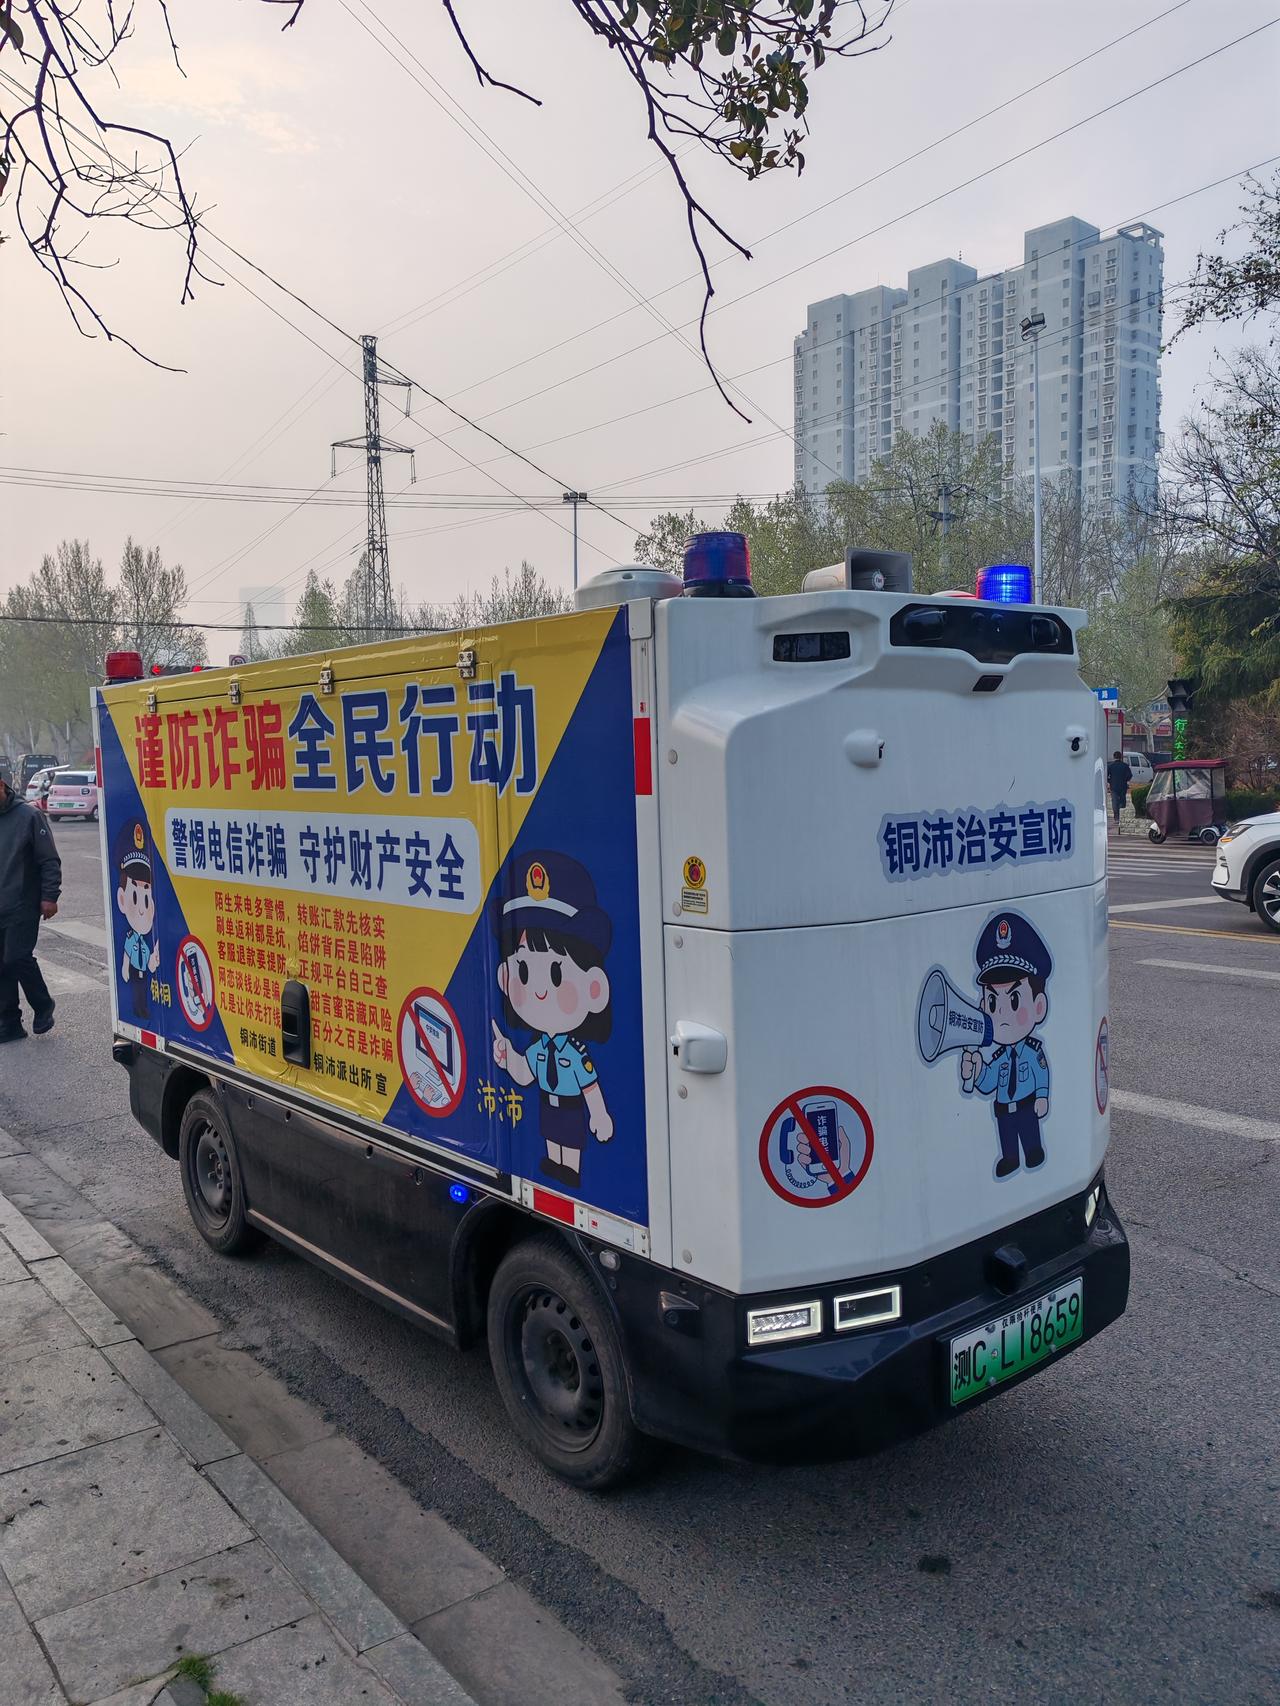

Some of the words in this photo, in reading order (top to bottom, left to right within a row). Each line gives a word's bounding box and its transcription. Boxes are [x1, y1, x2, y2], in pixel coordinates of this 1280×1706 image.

[171, 818, 288, 880] 警惕电信诈骗
[299, 825, 465, 900] 守护财产安全
[883, 806, 1072, 874] 铜沛治安宣防
[239, 1027, 277, 1057] 铜沛街道
[313, 1052, 372, 1091] 铜沛派出所
[477, 1078, 523, 1129] 沛沛
